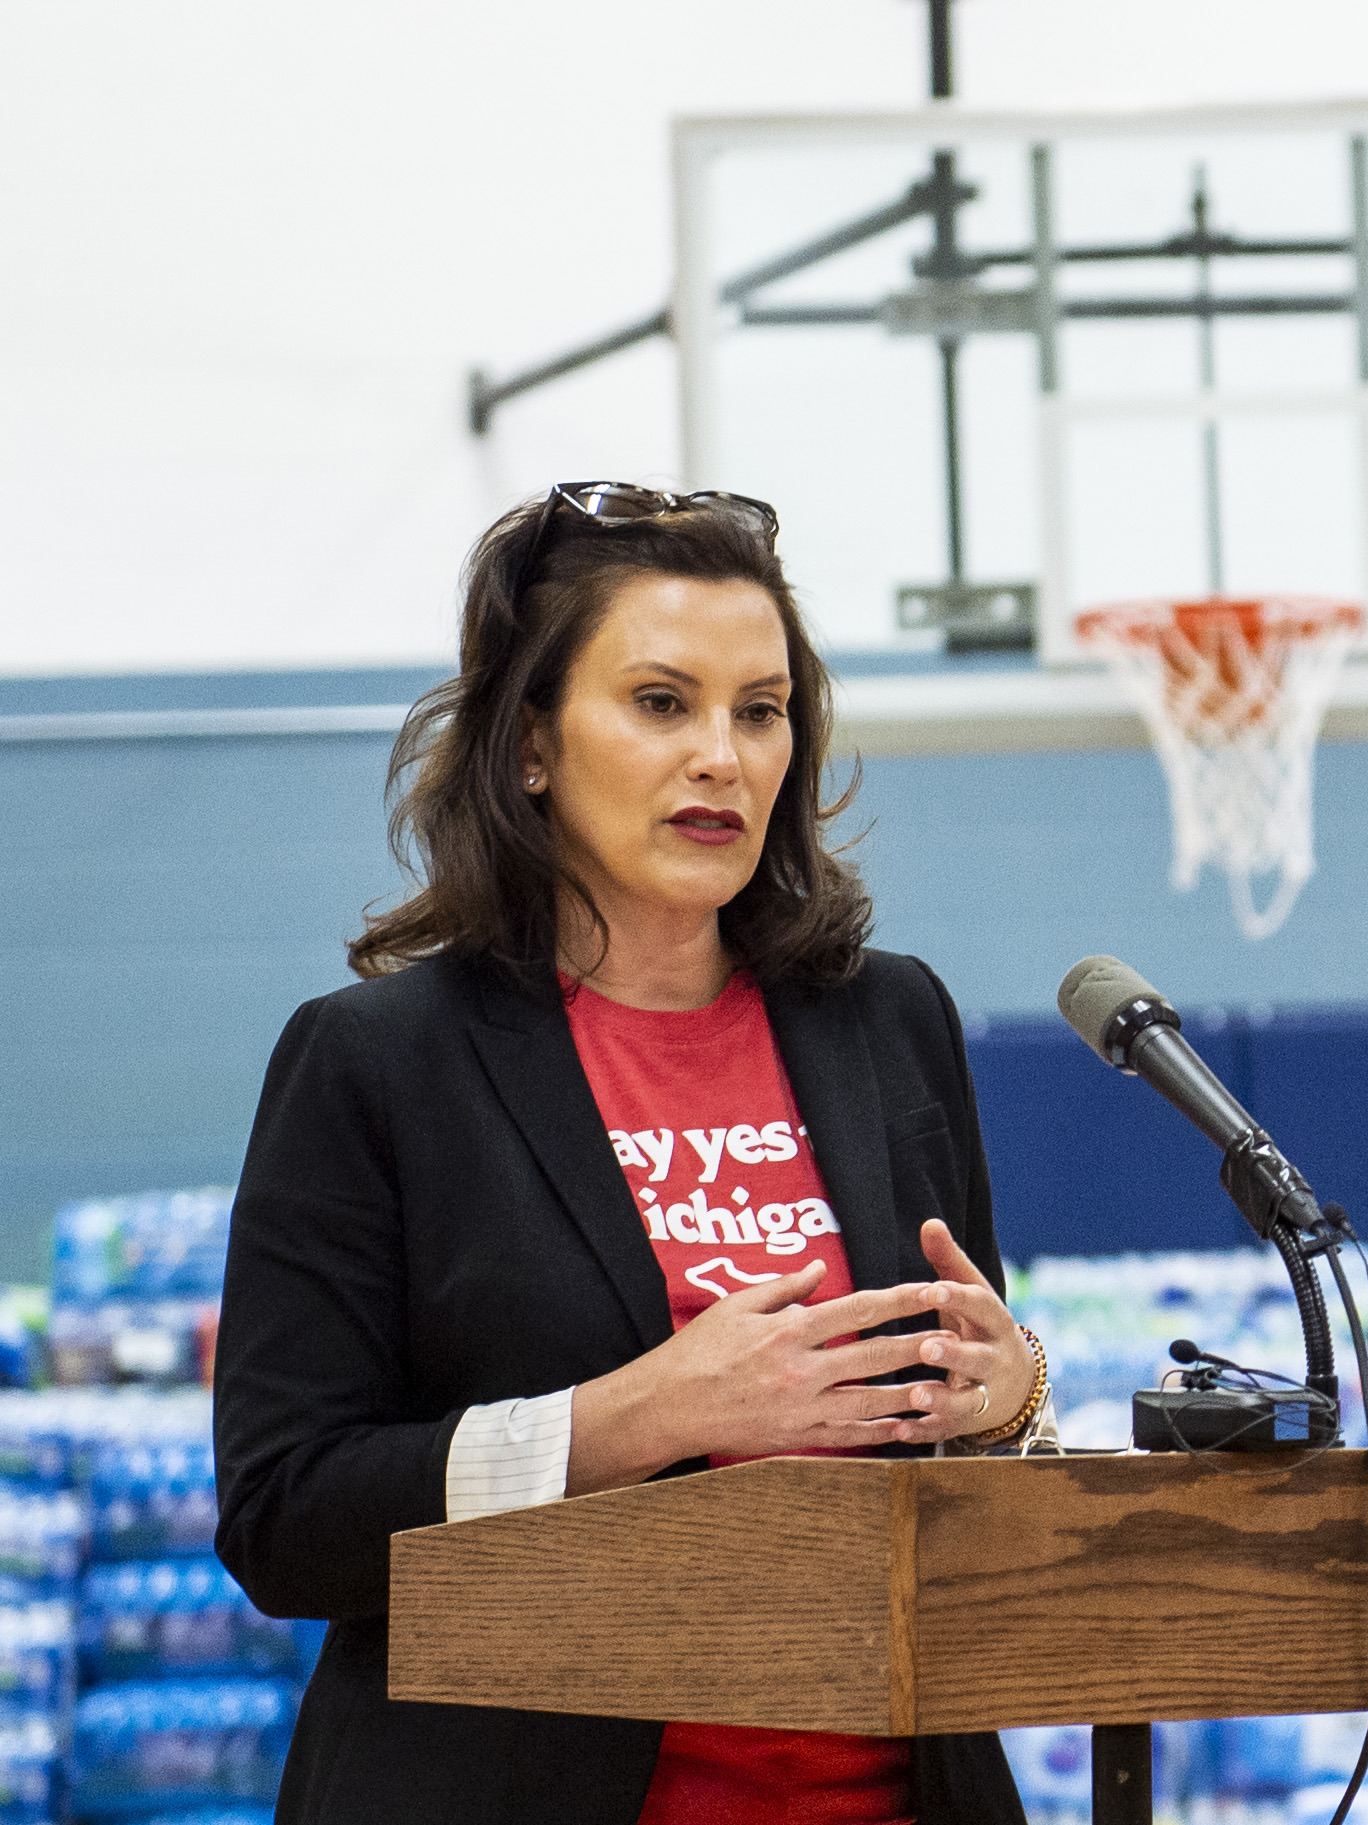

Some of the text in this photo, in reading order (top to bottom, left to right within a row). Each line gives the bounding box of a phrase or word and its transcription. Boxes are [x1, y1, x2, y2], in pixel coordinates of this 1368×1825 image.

[608, 1127, 674, 1182] ay
[682, 1121, 798, 1183] yes
[638, 1186, 842, 1255] ichiga
